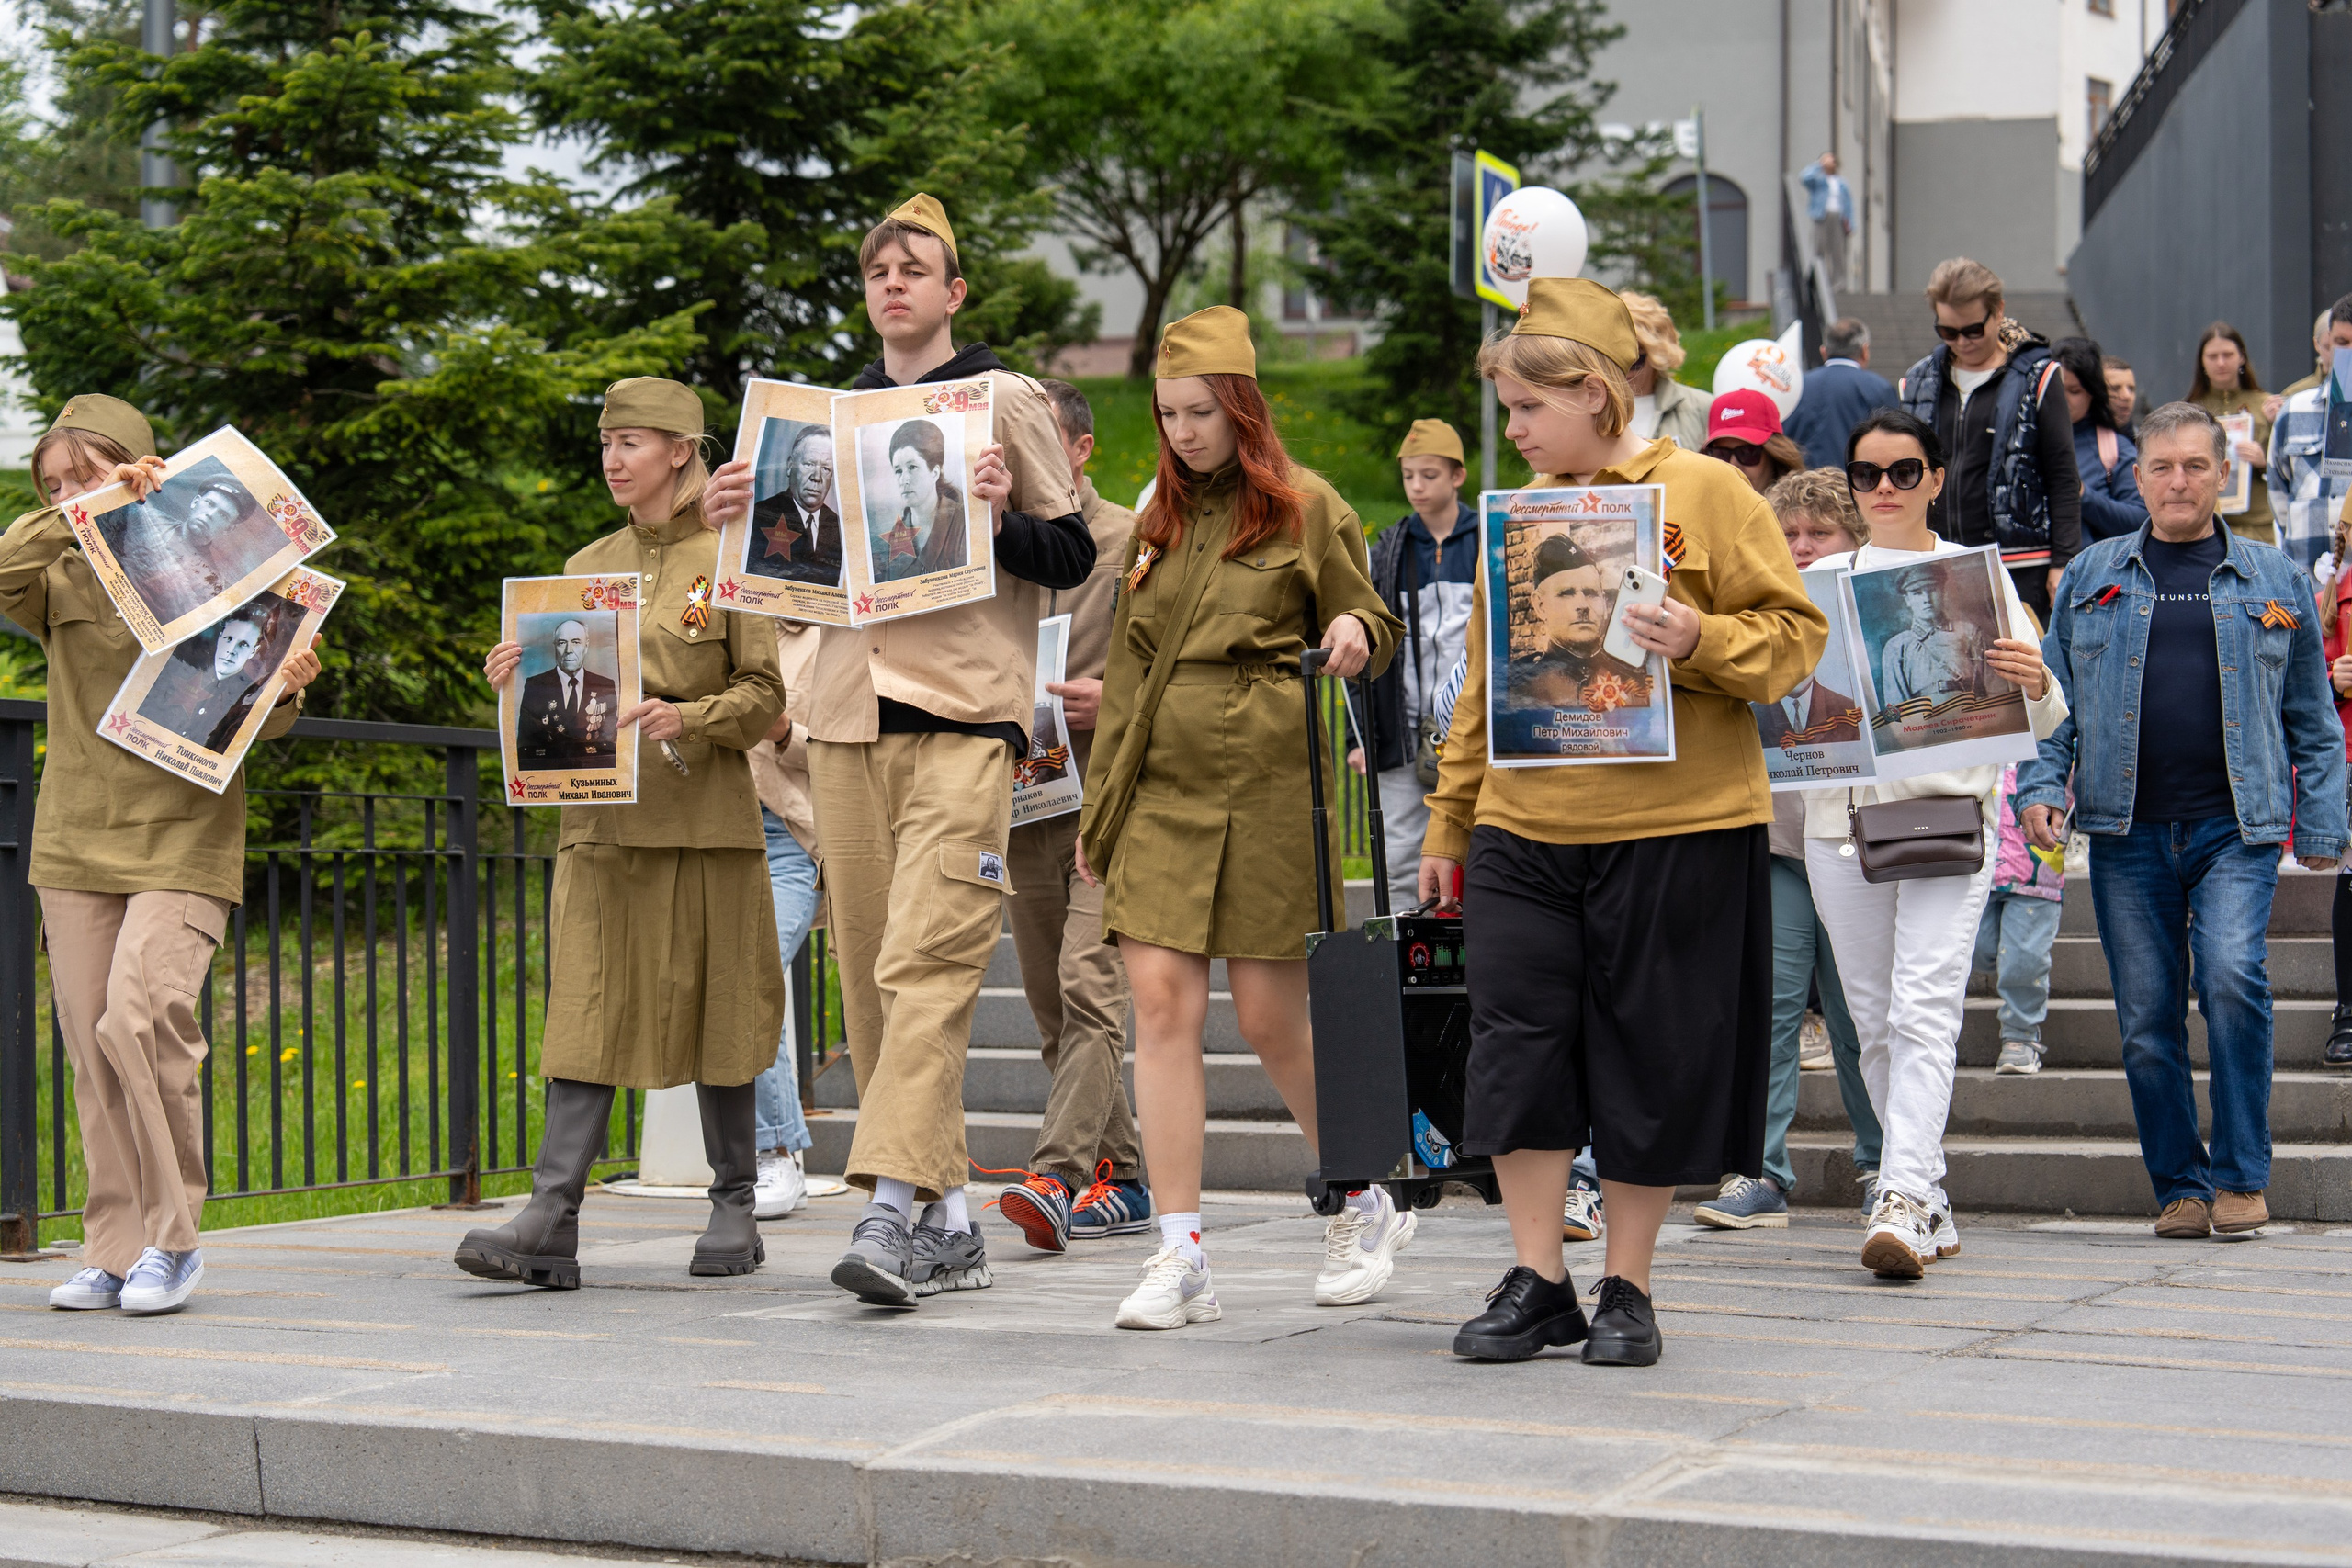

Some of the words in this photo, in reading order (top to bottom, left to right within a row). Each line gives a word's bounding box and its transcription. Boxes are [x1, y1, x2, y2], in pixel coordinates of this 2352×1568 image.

[955, 390, 969, 412] 9
[968, 401, 989, 412] мая
[1601, 503, 1632, 513] ПОЛК
[285, 517, 309, 538] 9
[80, 529, 96, 555] ПОЛК
[292, 536, 311, 555] мая
[307, 586, 322, 608] 9
[607, 586, 620, 610] 9
[620, 601, 638, 610] мая
[739, 595, 763, 606] ПОЛК
[876, 601, 899, 613] ПОЛК
[1554, 711, 1602, 724] Демидов
[1903, 722, 1939, 733] Мадеев
[1940, 713, 1996, 728] Сирачетдин
[1532, 726, 1559, 739] Петр
[1561, 726, 1628, 738] Михайлович
[125, 733, 149, 750] ПОЛК
[1562, 742, 1600, 752] рядовой
[176, 745, 218, 771] Тонконогов
[1784, 750, 1825, 763] Чернов
[154, 749, 190, 772] Николай
[189, 765, 223, 787] Павлович
[1804, 765, 1860, 778] Петрович
[571, 778, 617, 789] Кузьминых
[528, 791, 548, 799] ПОЛК
[559, 791, 589, 800] Михаил
[591, 790, 632, 799] Иванович
[1023, 793, 1079, 814] Николаевич
